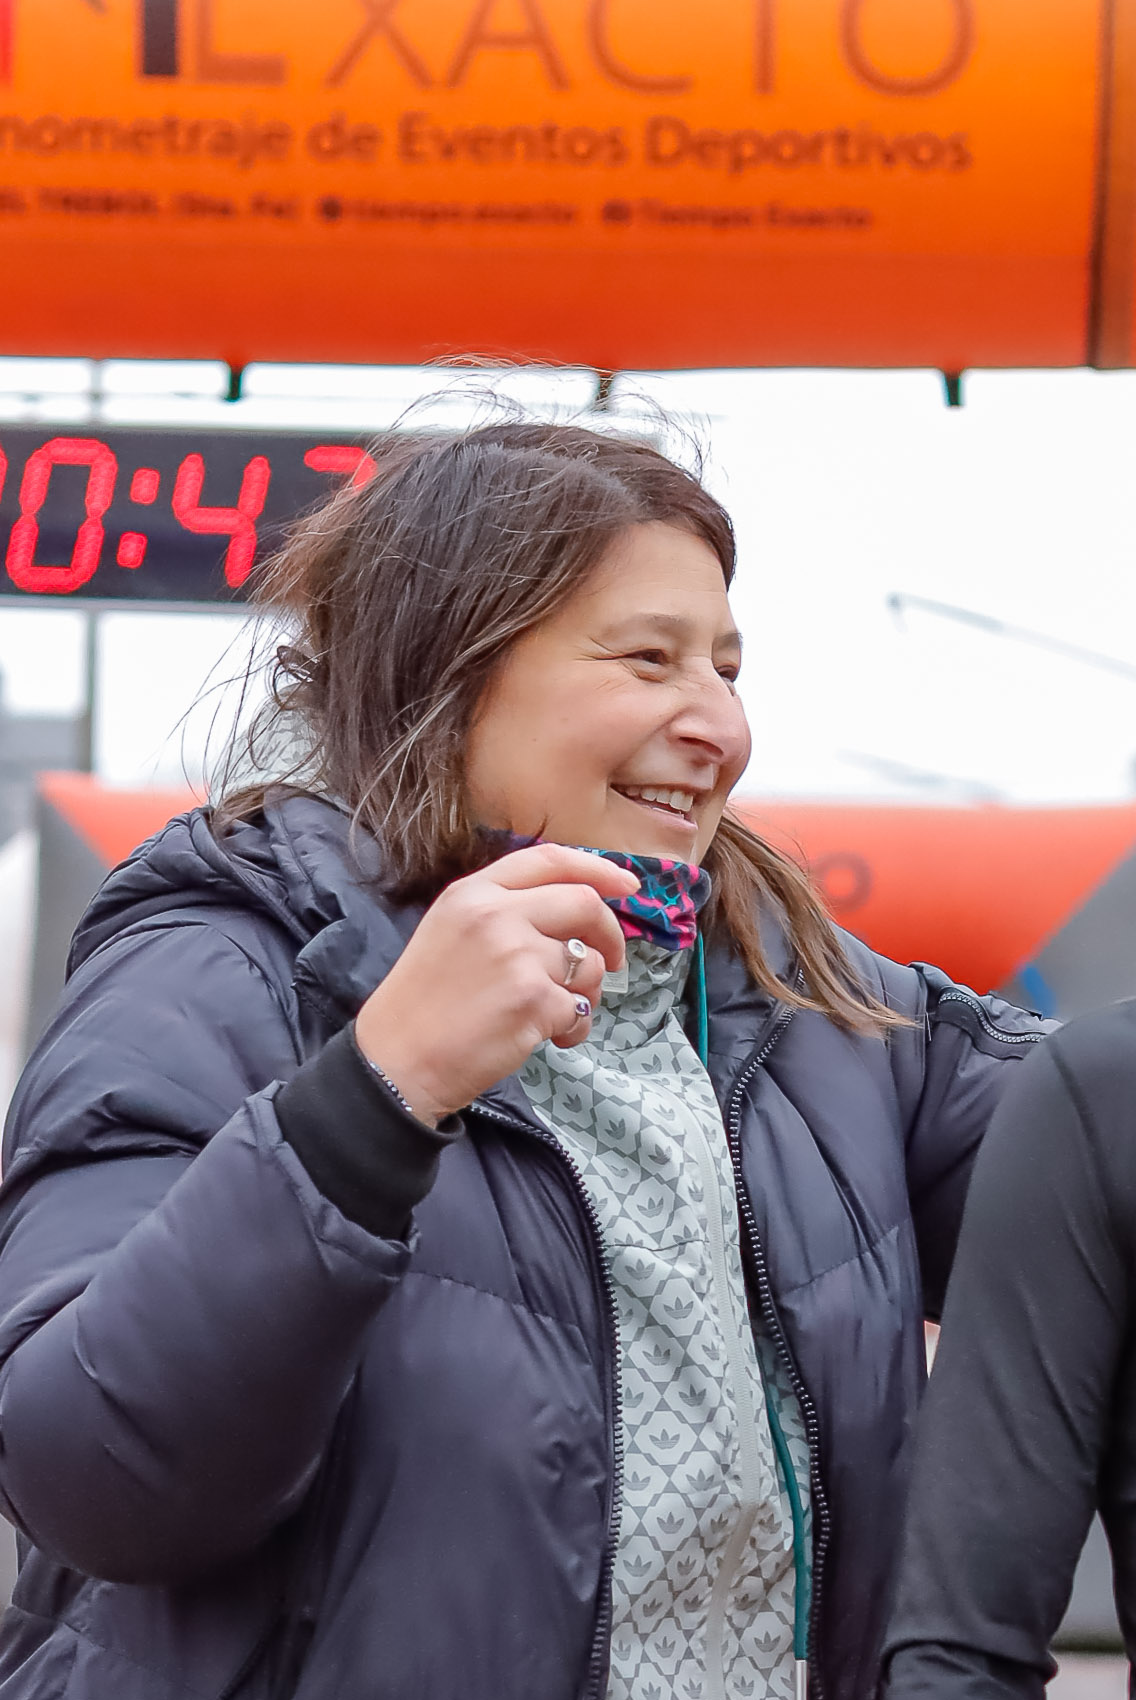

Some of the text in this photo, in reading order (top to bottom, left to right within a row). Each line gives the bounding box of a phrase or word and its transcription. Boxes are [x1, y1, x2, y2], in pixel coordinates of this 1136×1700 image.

[305, 109, 382, 166] de
[398, 110, 631, 168] Eventos
[643, 114, 976, 181] Deportivos
